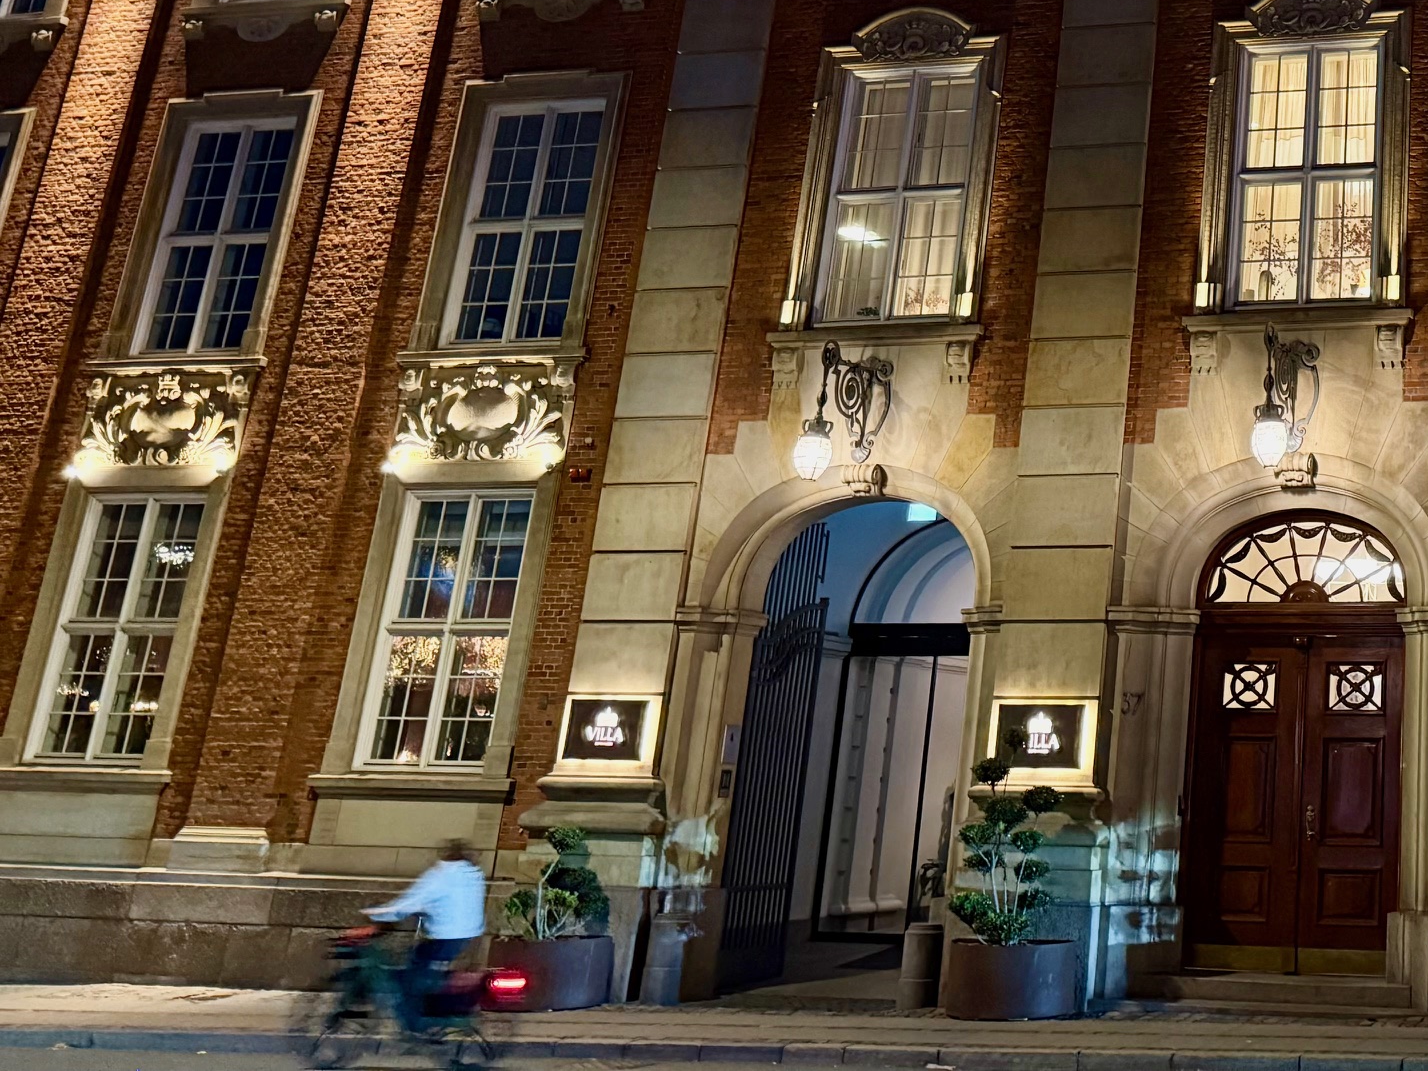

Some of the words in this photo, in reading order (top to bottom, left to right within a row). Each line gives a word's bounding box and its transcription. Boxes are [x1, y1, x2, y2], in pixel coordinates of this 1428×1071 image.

[1121, 692, 1145, 716] 37
[585, 725, 624, 743] VILLA
[1024, 733, 1060, 750] ILLA
